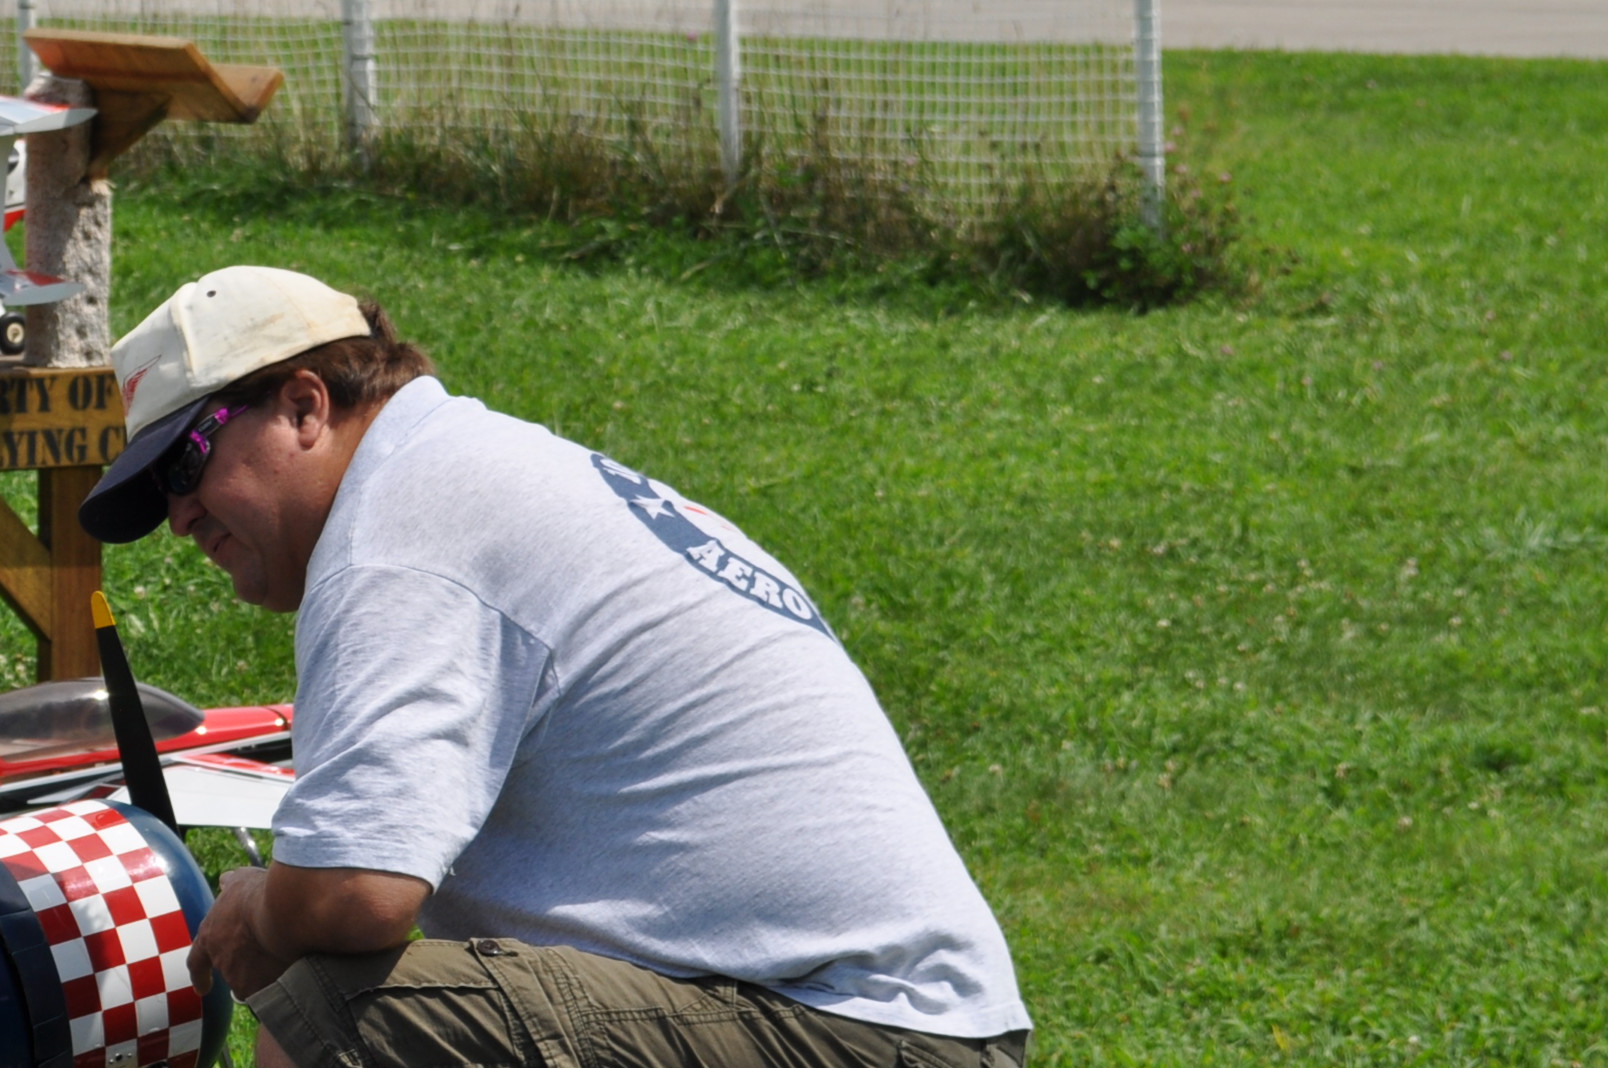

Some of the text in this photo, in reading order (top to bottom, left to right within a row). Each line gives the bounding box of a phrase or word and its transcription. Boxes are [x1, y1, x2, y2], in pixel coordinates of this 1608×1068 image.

[68, 374, 117, 411] OF
[98, 425, 127, 465] C
[686, 540, 812, 620] AERO
